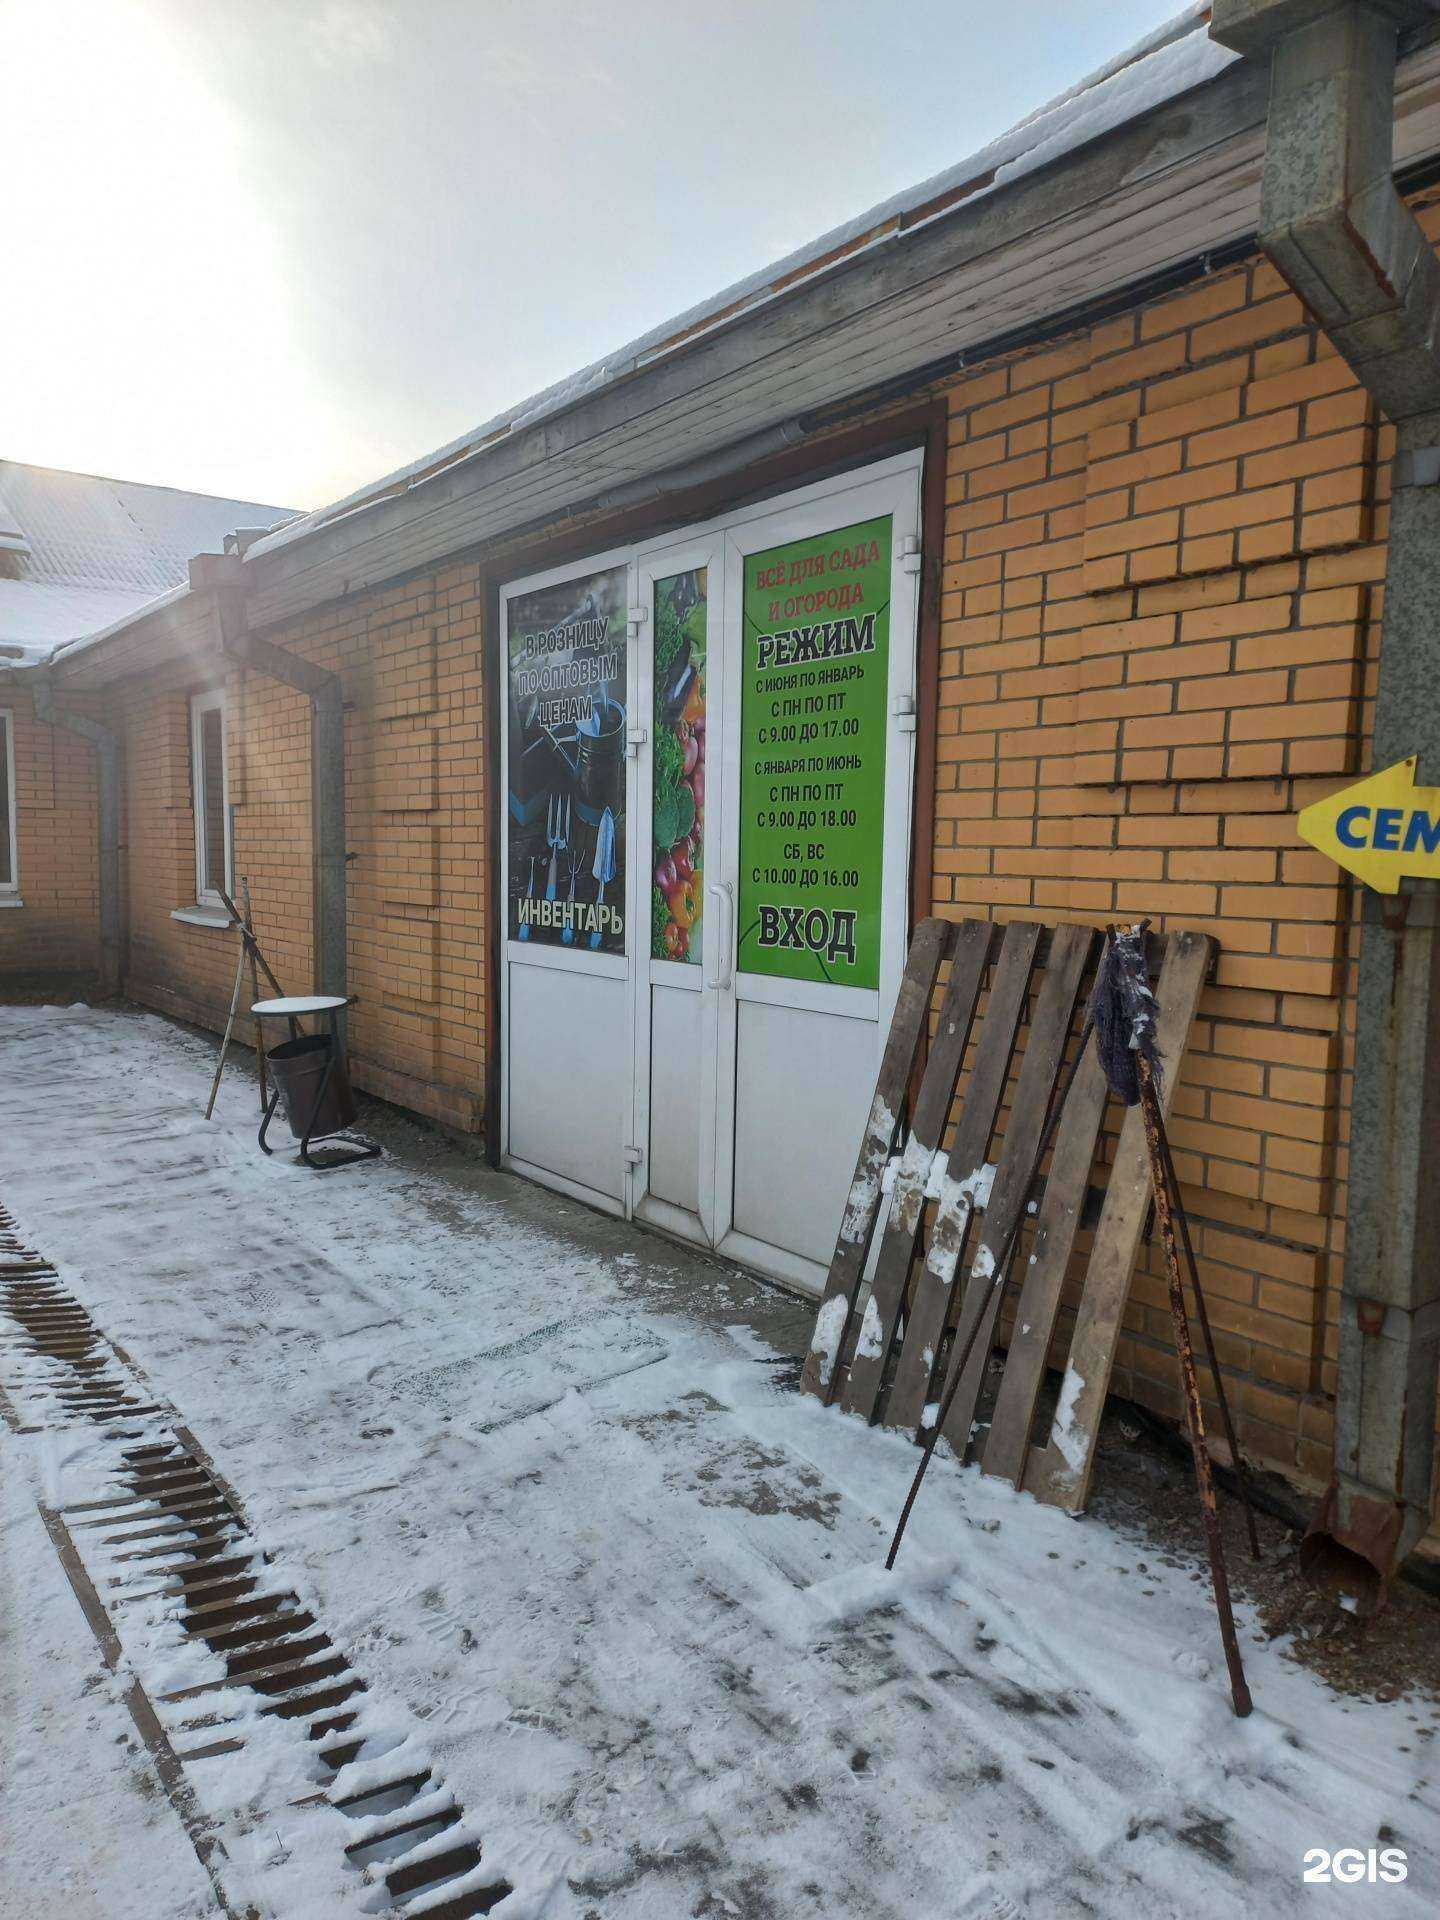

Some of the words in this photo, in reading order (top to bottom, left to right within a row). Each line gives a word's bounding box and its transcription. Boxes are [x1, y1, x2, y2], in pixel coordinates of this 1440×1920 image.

[757, 562, 785, 590] ВСЁ
[790, 553, 825, 586] ДЛЯ
[829, 541, 880, 571] САДА
[768, 602, 781, 621] И
[784, 582, 864, 616] ОГОРОДА
[526, 635, 535, 660] В
[538, 616, 609, 656] РОЗНИЦУ
[757, 613, 877, 670] РЕЖИМ
[518, 669, 541, 696] ПО
[542, 653, 617, 691] ОПТОВЫМ
[756, 680, 763, 693] С
[766, 674, 797, 692] ИЮНЯ
[800, 672, 815, 687] ПО
[818, 666, 864, 685] ЯНВАРЬ
[539, 696, 592, 730] ЦЕНАМ
[772, 702, 780, 717] С
[783, 699, 801, 716] ПН
[805, 696, 823, 713] ПО
[828, 693, 846, 710] ПТ
[759, 729, 767, 744] С
[770, 725, 796, 743] 9.00
[800, 724, 818, 743] ДО
[823, 718, 859, 737] 17.00
[755, 762, 761, 775] С
[764, 759, 805, 775] ЯНВАРЯ
[808, 757, 823, 772] ПО
[827, 755, 862, 770] ИЮНЬ
[770, 787, 777, 802] С
[781, 786, 799, 801] ПН
[803, 785, 821, 801] ПО
[825, 784, 844, 800] ПТ
[758, 813, 765, 827] С
[769, 812, 794, 827] 9.00
[798, 811, 816, 830] ДО
[821, 810, 856, 827] 18.00
[784, 844, 803, 862] СБ,
[808, 844, 825, 859] ВС
[753, 868, 760, 883] С
[764, 869, 797, 885] 10.00
[800, 870, 819, 888] ДО
[823, 871, 859, 887] 16.00
[518, 898, 624, 934] ИНВЕНТАРЬ
[758, 905, 857, 965] ВХОД
